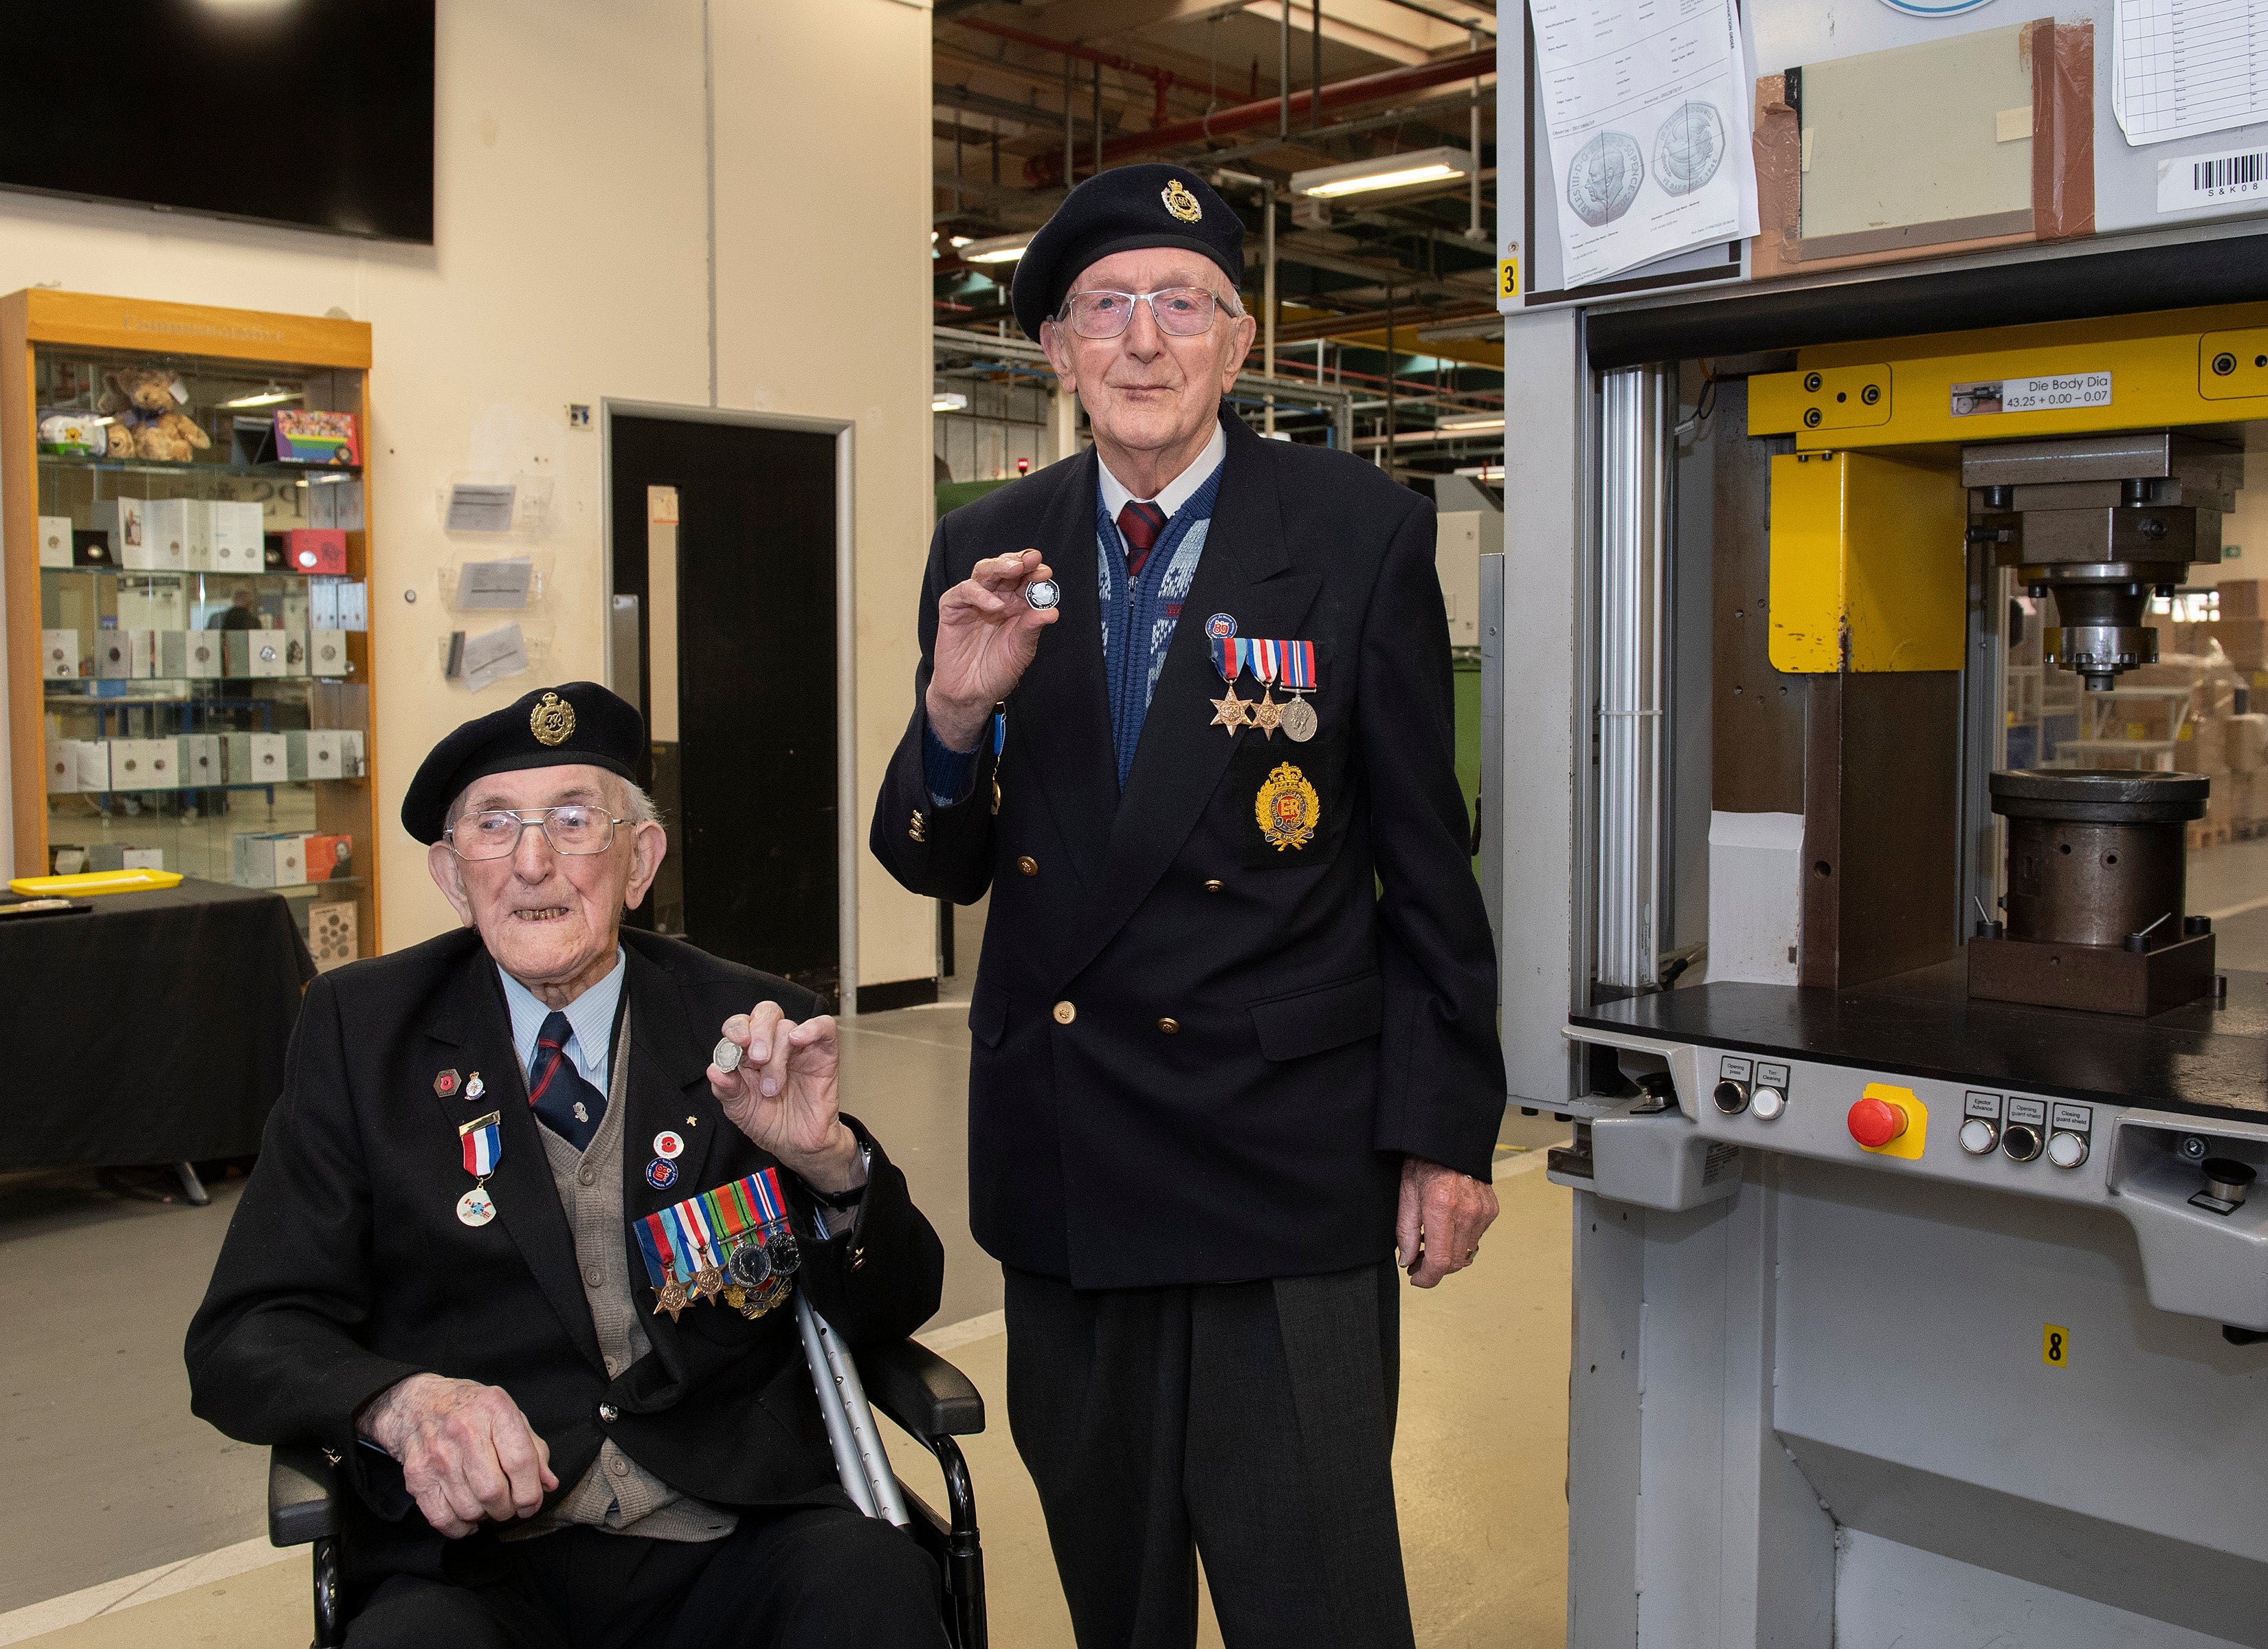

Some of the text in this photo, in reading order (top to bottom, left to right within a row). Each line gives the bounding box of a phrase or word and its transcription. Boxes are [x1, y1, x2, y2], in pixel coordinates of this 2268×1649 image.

[1504, 265, 1515, 293] 3
[2029, 376, 2108, 392] Die Body Dia
[2007, 396, 2036, 408] 43.25
[2048, 393, 2073, 405] 0.00
[2083, 390, 2108, 403] 0.07
[1212, 623, 1230, 636] 80
[1727, 1063, 1744, 1071] Opening
[2016, 1105, 2037, 1113] Opening
[2061, 1110, 2080, 1119] Closing
[653, 1163, 667, 1182] 80
[2049, 1332, 2062, 1361] 8
